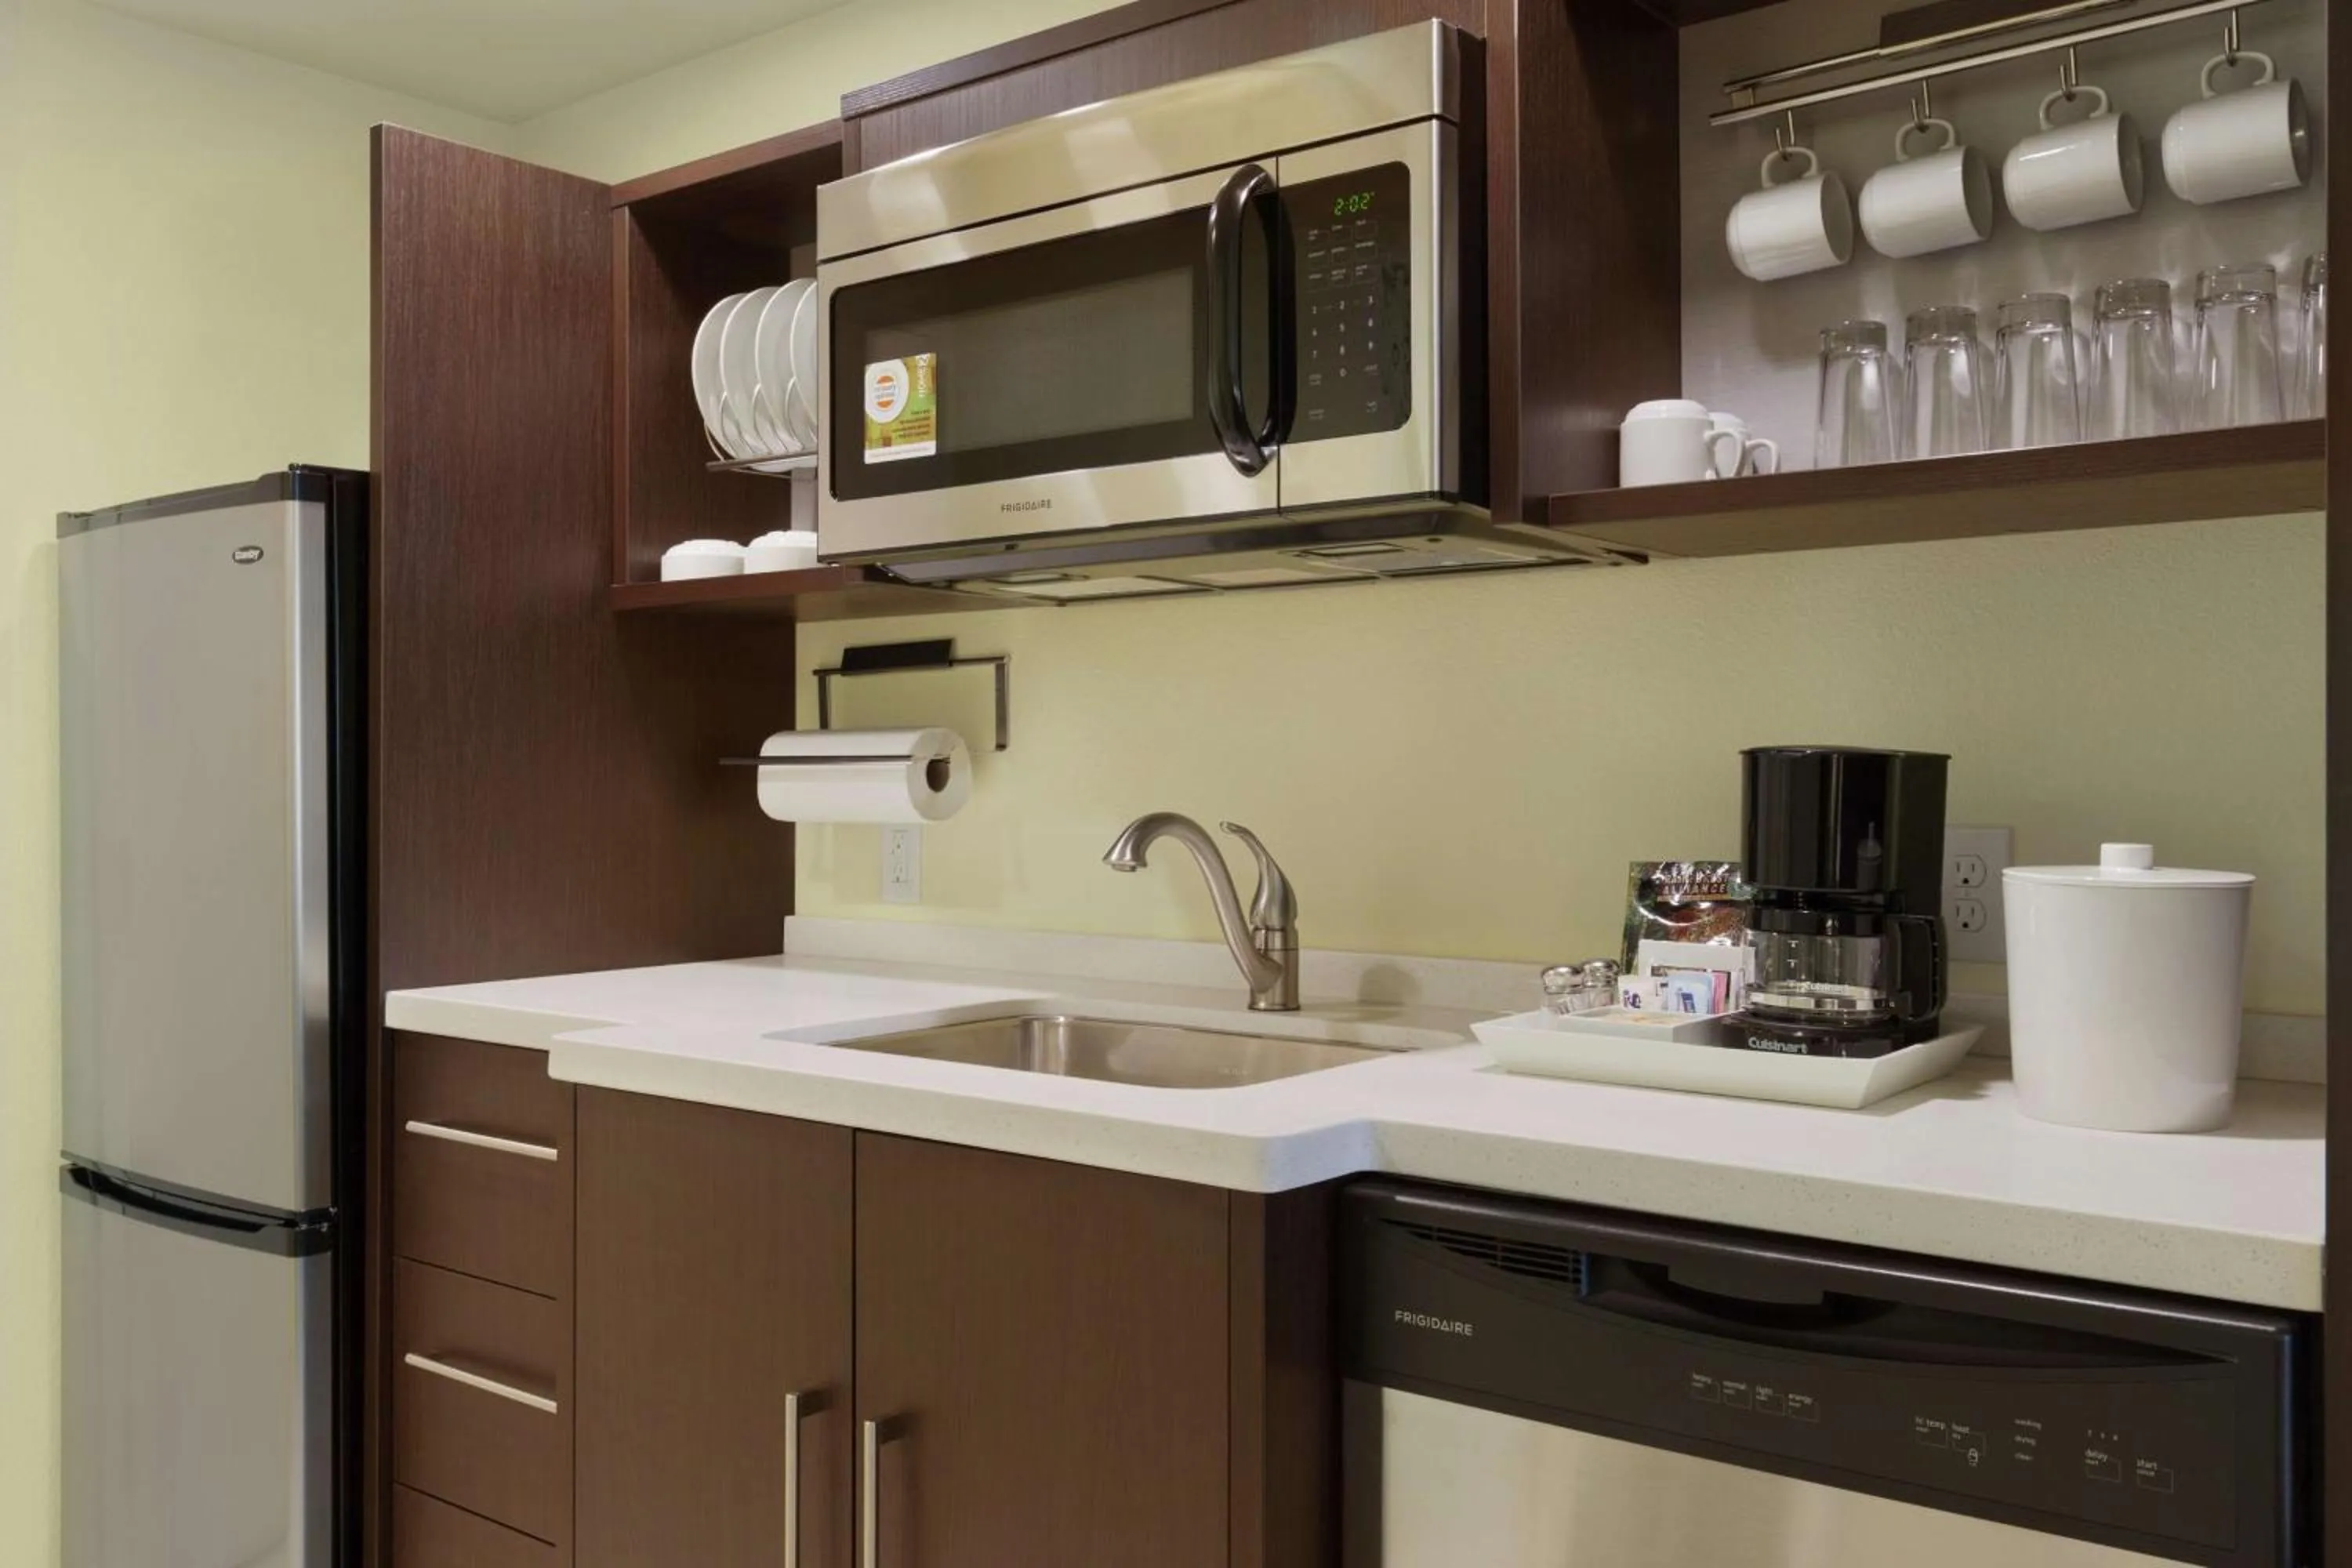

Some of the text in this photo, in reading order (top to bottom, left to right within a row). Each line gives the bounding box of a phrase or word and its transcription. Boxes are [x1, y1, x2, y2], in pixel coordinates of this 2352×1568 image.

[1334, 194, 1370, 216] 2:02
[1748, 1036, 1808, 1054] Cuisinart
[1395, 1310, 1474, 1336] FRIGIDAIRE
